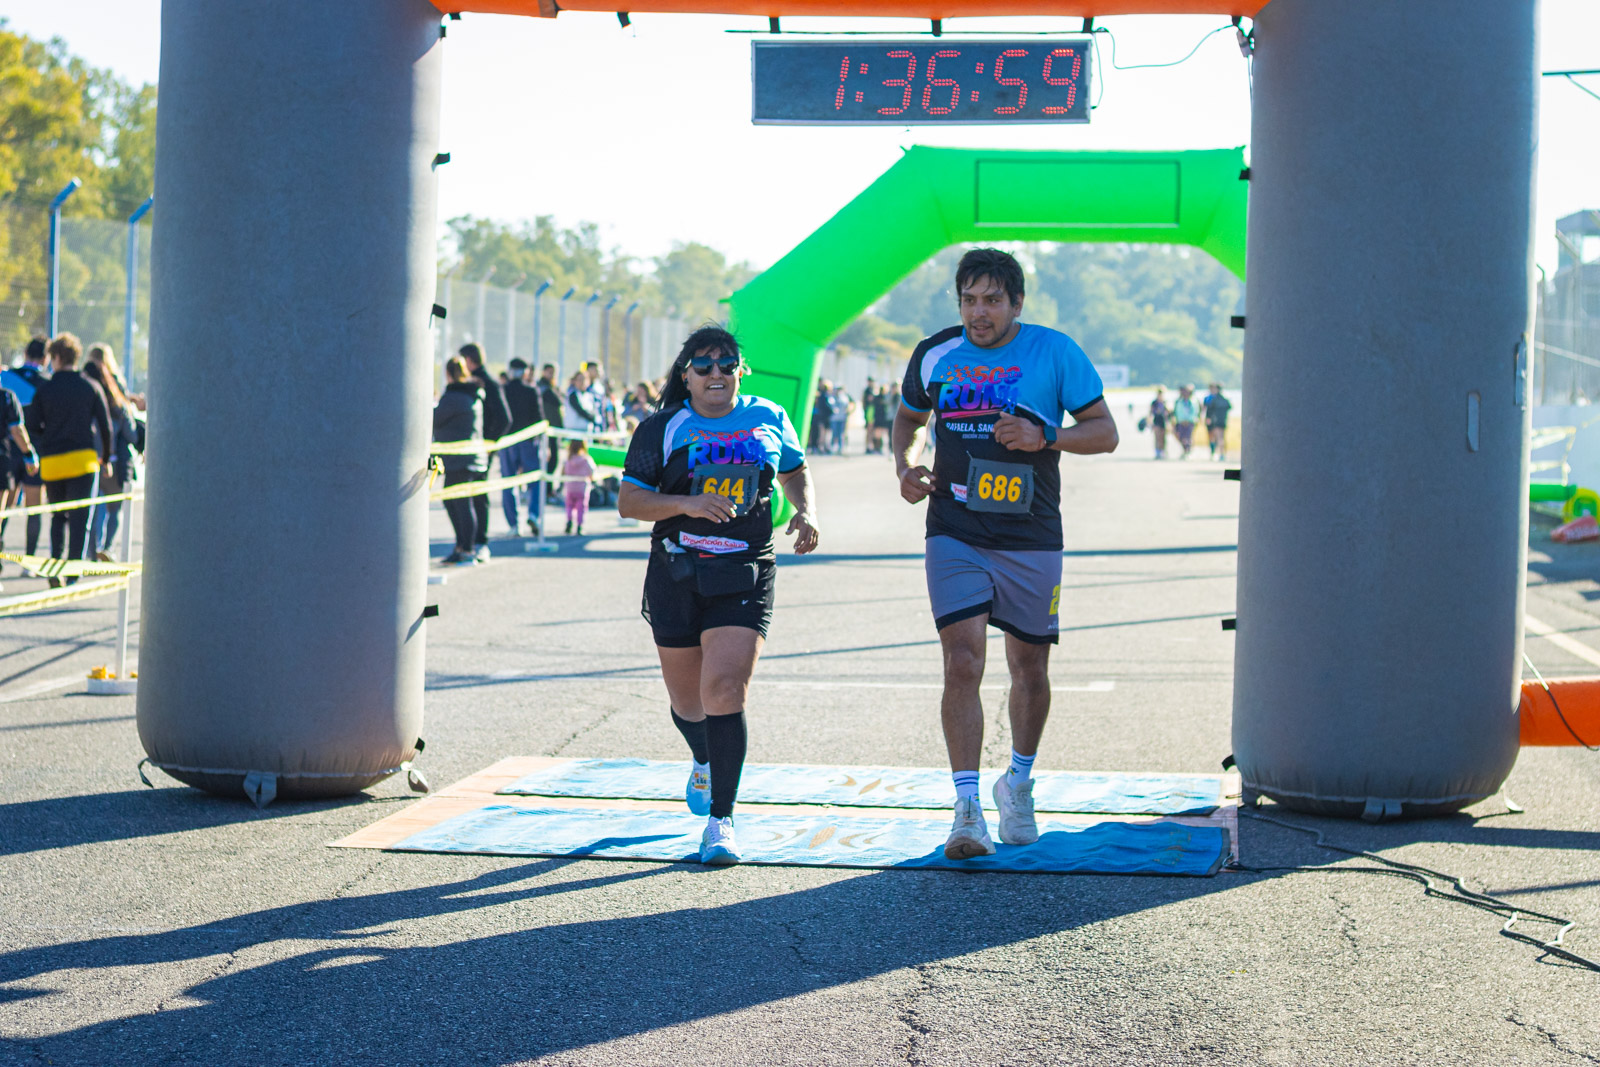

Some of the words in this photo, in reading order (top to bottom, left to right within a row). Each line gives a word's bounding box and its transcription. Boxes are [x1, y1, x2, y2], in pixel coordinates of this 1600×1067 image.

[835, 49, 1081, 115] 1:36:59
[946, 421, 976, 433] RAFAELA,
[977, 423, 995, 433] SAN
[703, 477, 744, 504] 644
[978, 472, 1022, 502] 686
